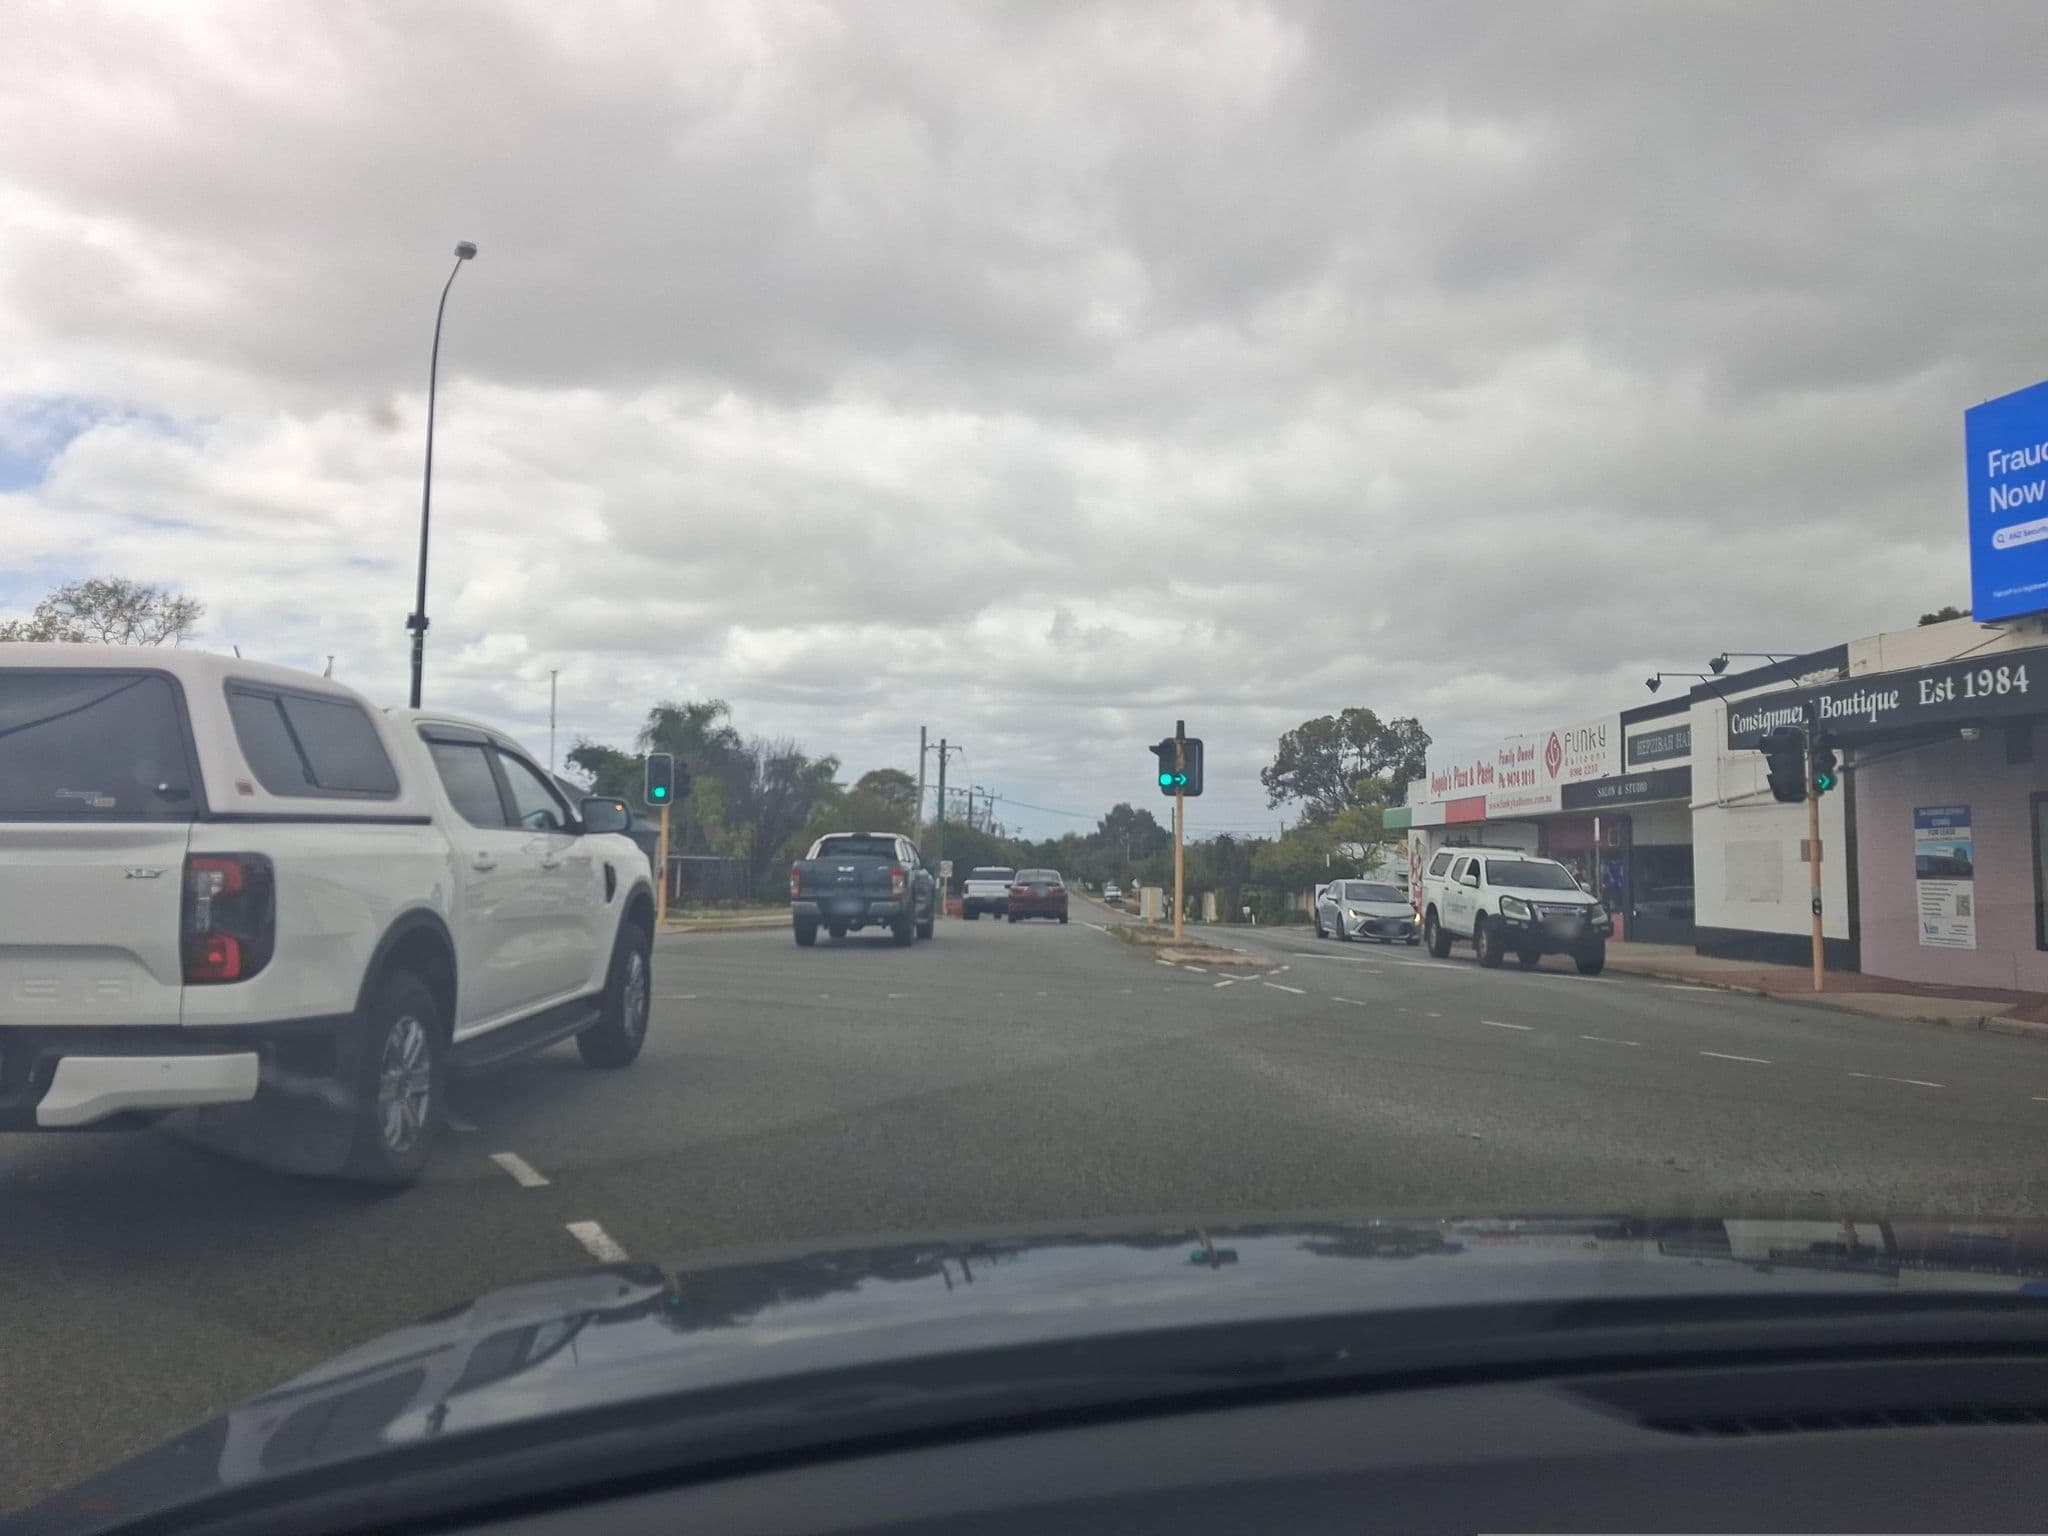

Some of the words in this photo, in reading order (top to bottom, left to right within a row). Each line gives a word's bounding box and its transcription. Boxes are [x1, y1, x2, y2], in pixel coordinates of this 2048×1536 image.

[1989, 479, 2046, 513] Now
[1731, 703, 1812, 738] Consignmen
[1819, 690, 1900, 723] Boutique
[1918, 676, 1957, 705] Est
[1962, 664, 2030, 698] 1984
